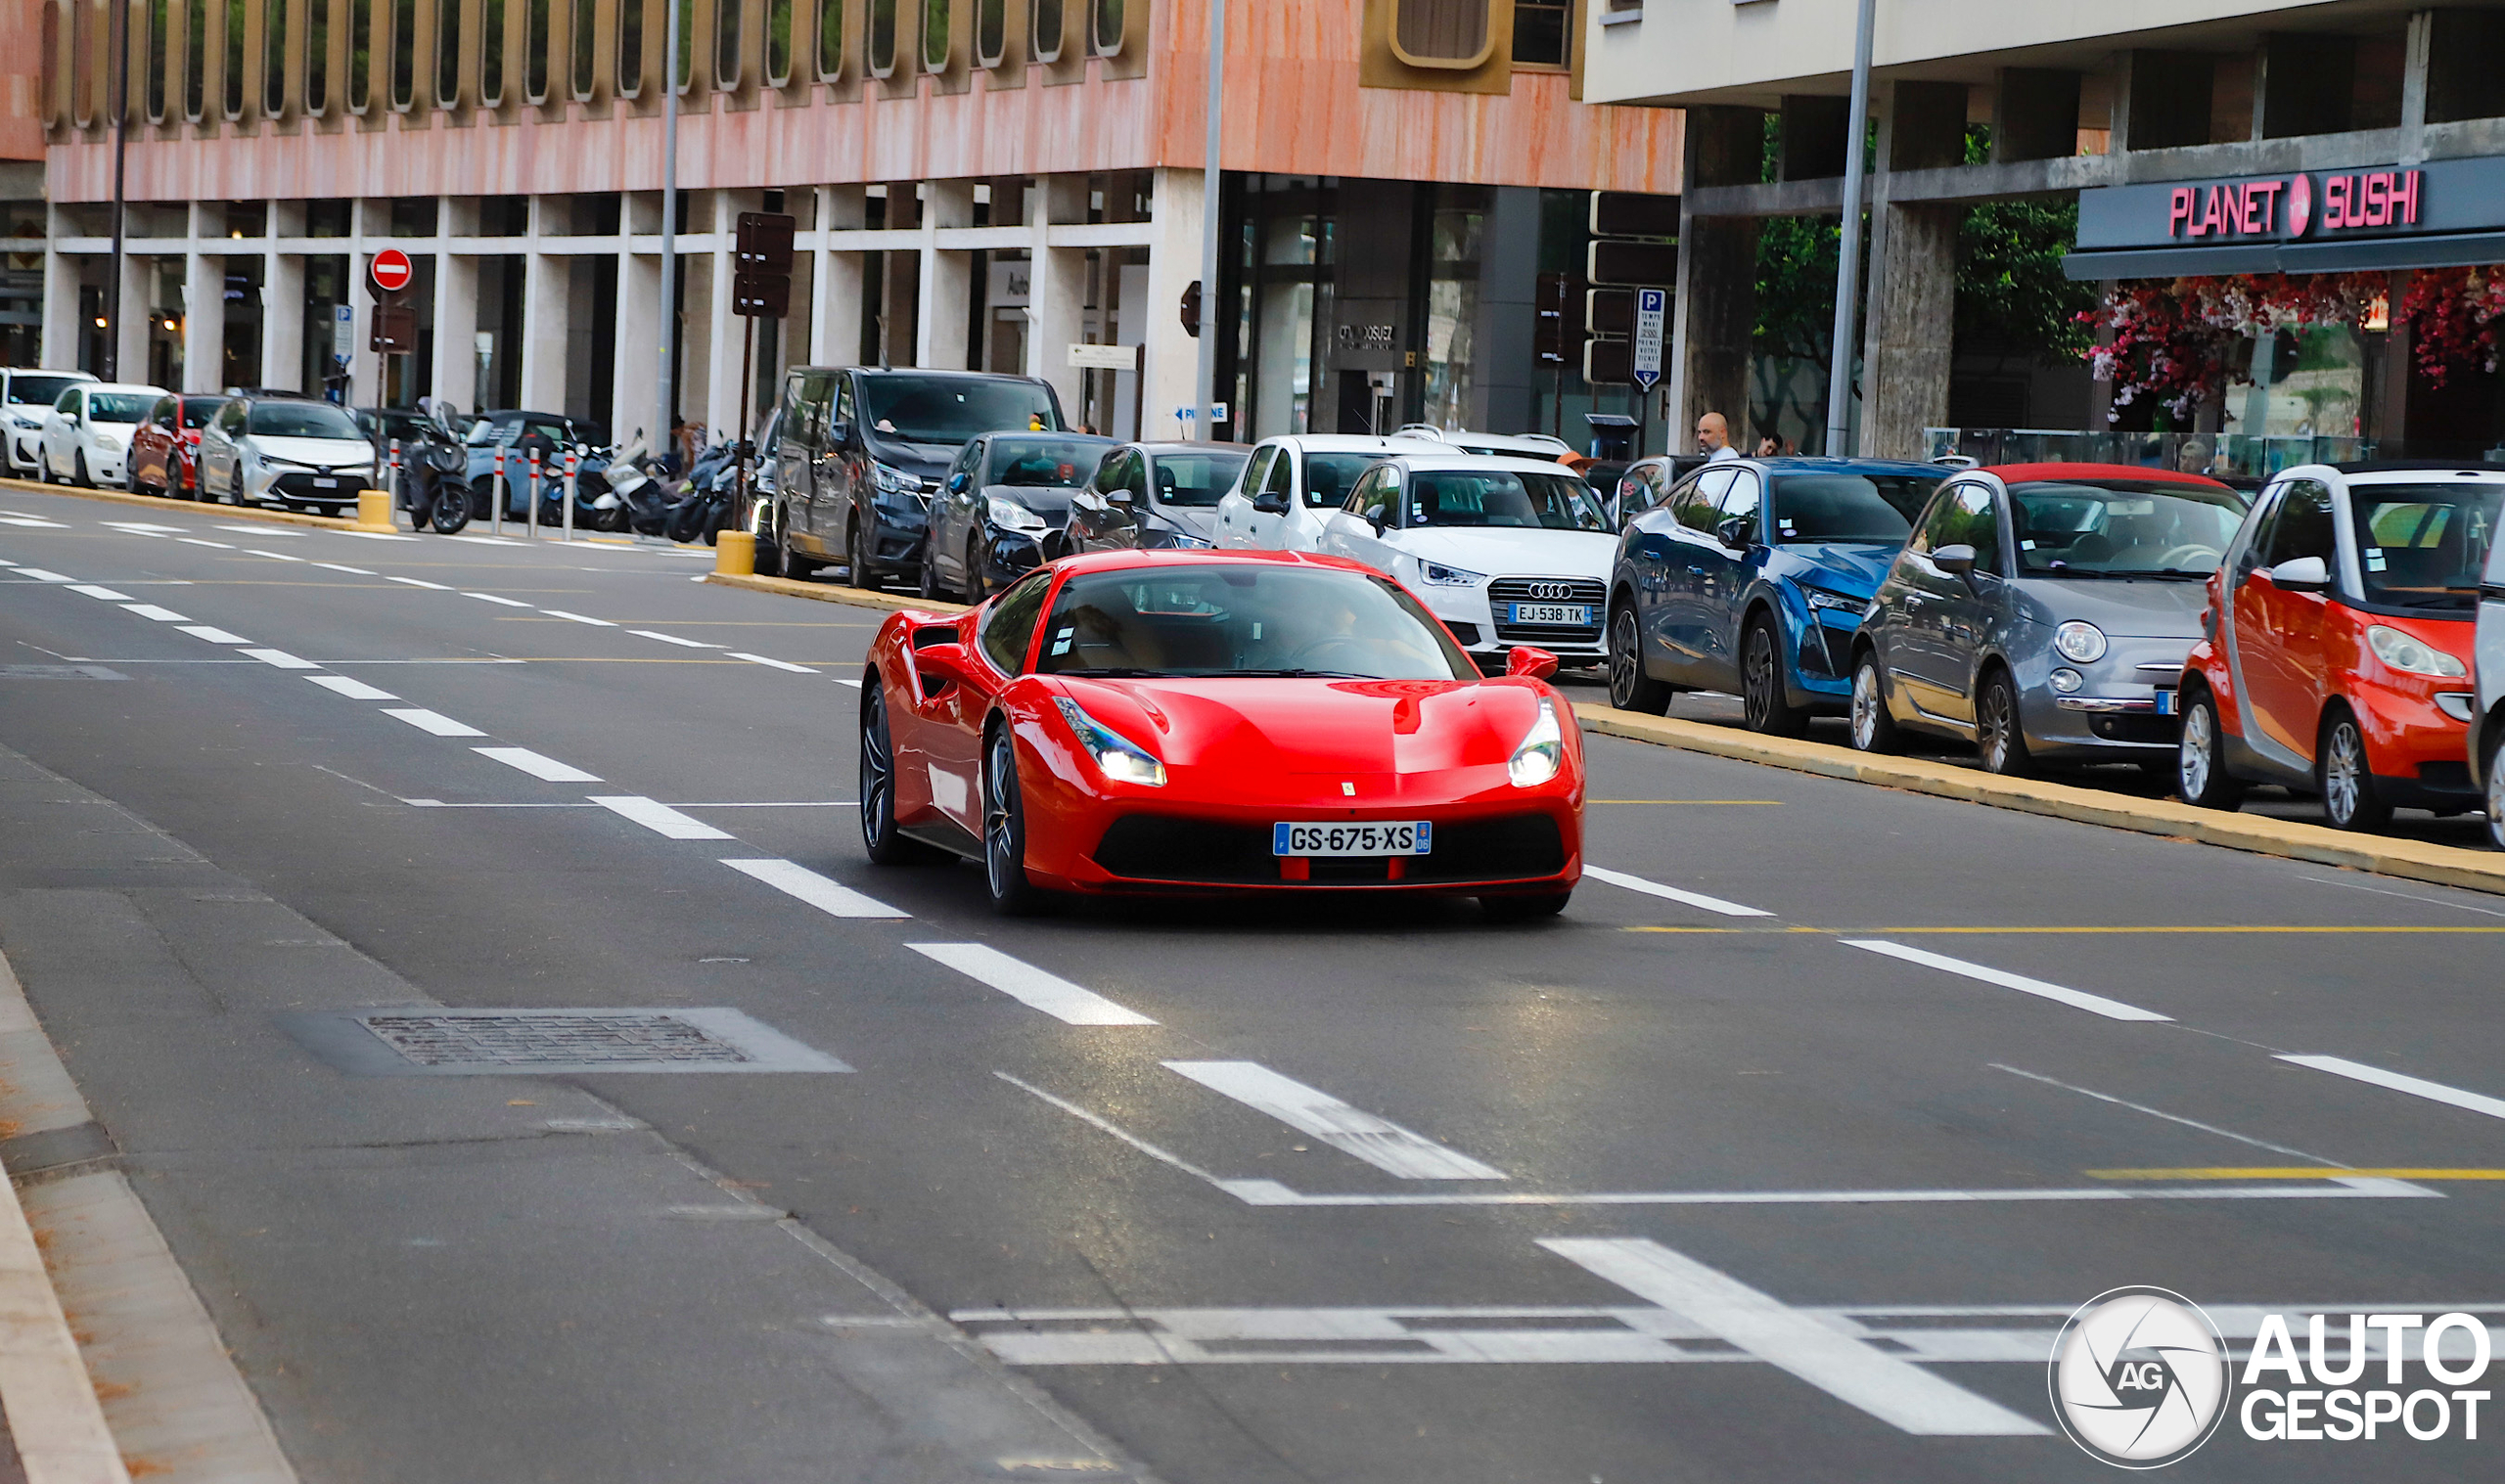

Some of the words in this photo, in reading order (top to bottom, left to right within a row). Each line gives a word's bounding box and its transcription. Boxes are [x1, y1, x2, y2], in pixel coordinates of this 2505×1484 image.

[2168, 180, 2283, 237] PLANET
[2324, 170, 2420, 229] SUSHI
[1647, 293, 1658, 309] P
[1185, 407, 1223, 419] PINE
[1292, 827, 1413, 851] GS-675-XS
